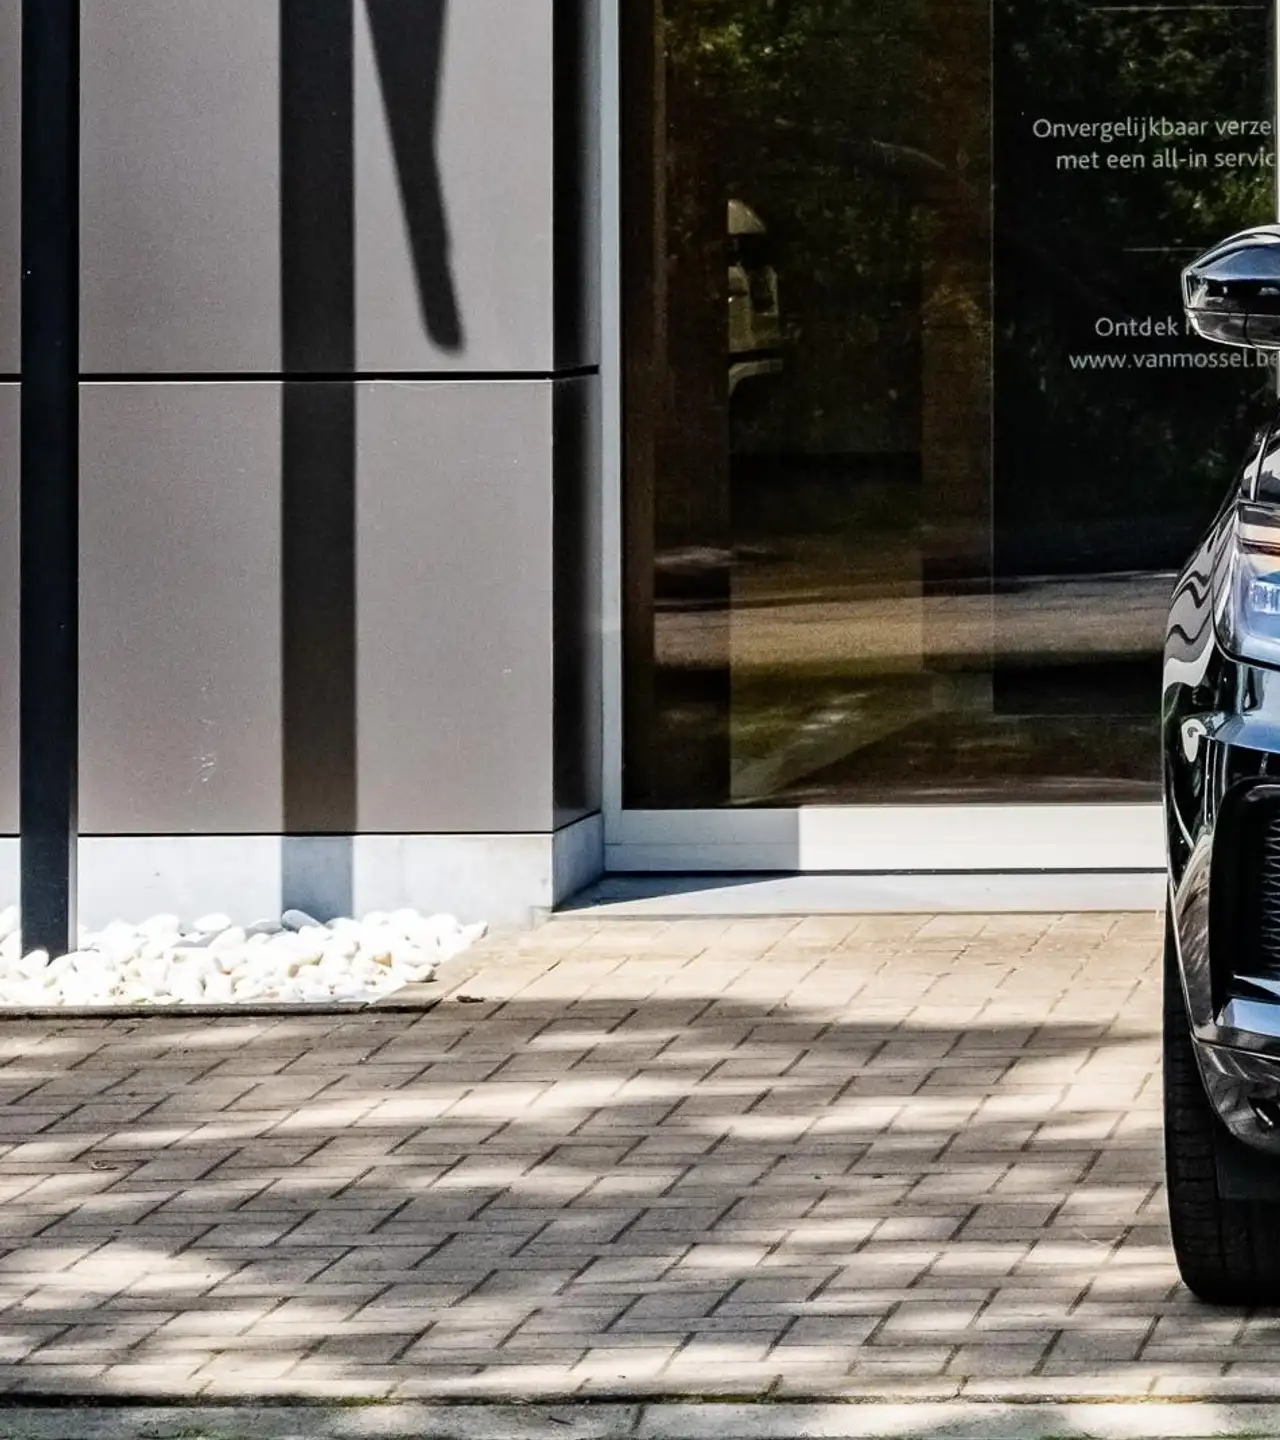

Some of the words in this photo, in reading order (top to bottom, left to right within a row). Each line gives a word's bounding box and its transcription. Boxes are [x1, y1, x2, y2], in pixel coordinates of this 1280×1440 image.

[1032, 116, 1209, 143] Onvergelijkbaar
[1057, 152, 1099, 169] met
[1107, 154, 1146, 169] een
[1152, 147, 1208, 169] all-in
[1095, 315, 1179, 338] Ontdek
